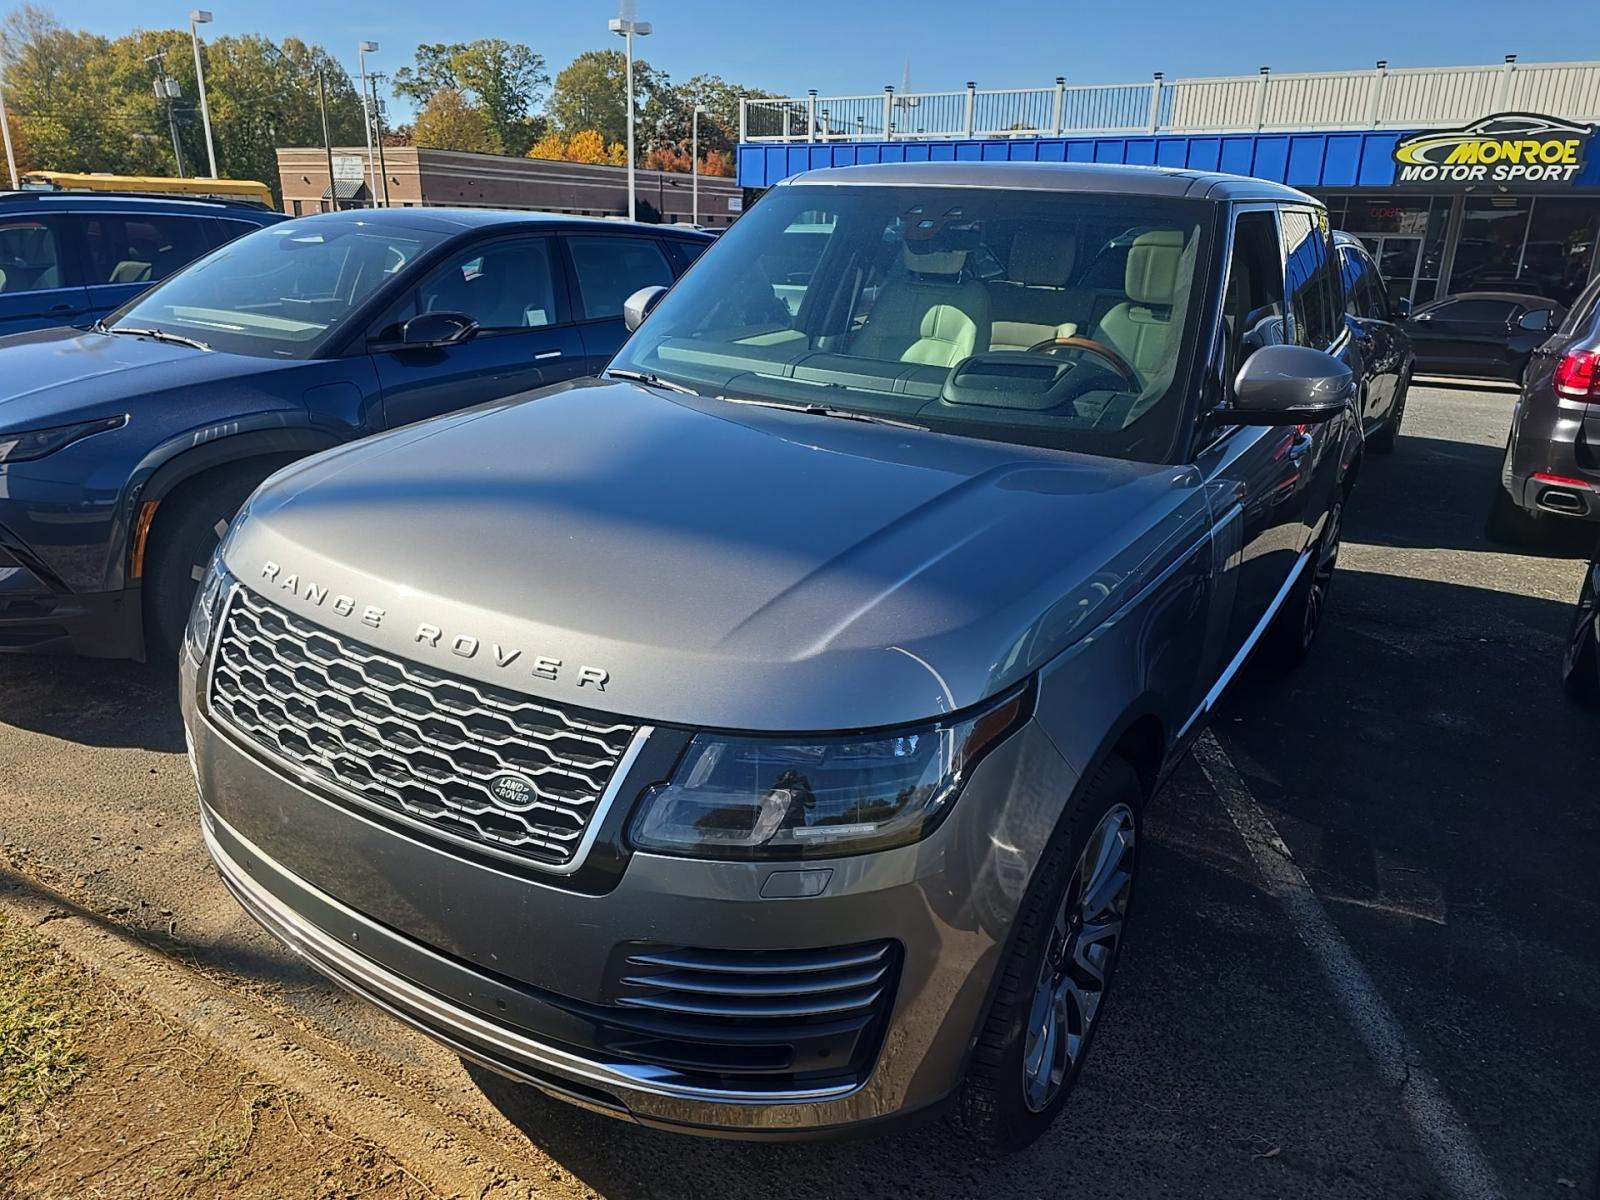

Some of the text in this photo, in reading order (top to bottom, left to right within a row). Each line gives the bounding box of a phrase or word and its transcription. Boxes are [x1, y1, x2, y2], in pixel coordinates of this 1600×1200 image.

[1444, 139, 1580, 164] MONROE
[1400, 165, 1580, 181] MOTOR SPORT
[262, 560, 610, 692] RANGE ROVER
[499, 778, 524, 792] LAND
[499, 787, 529, 803] ROVER
